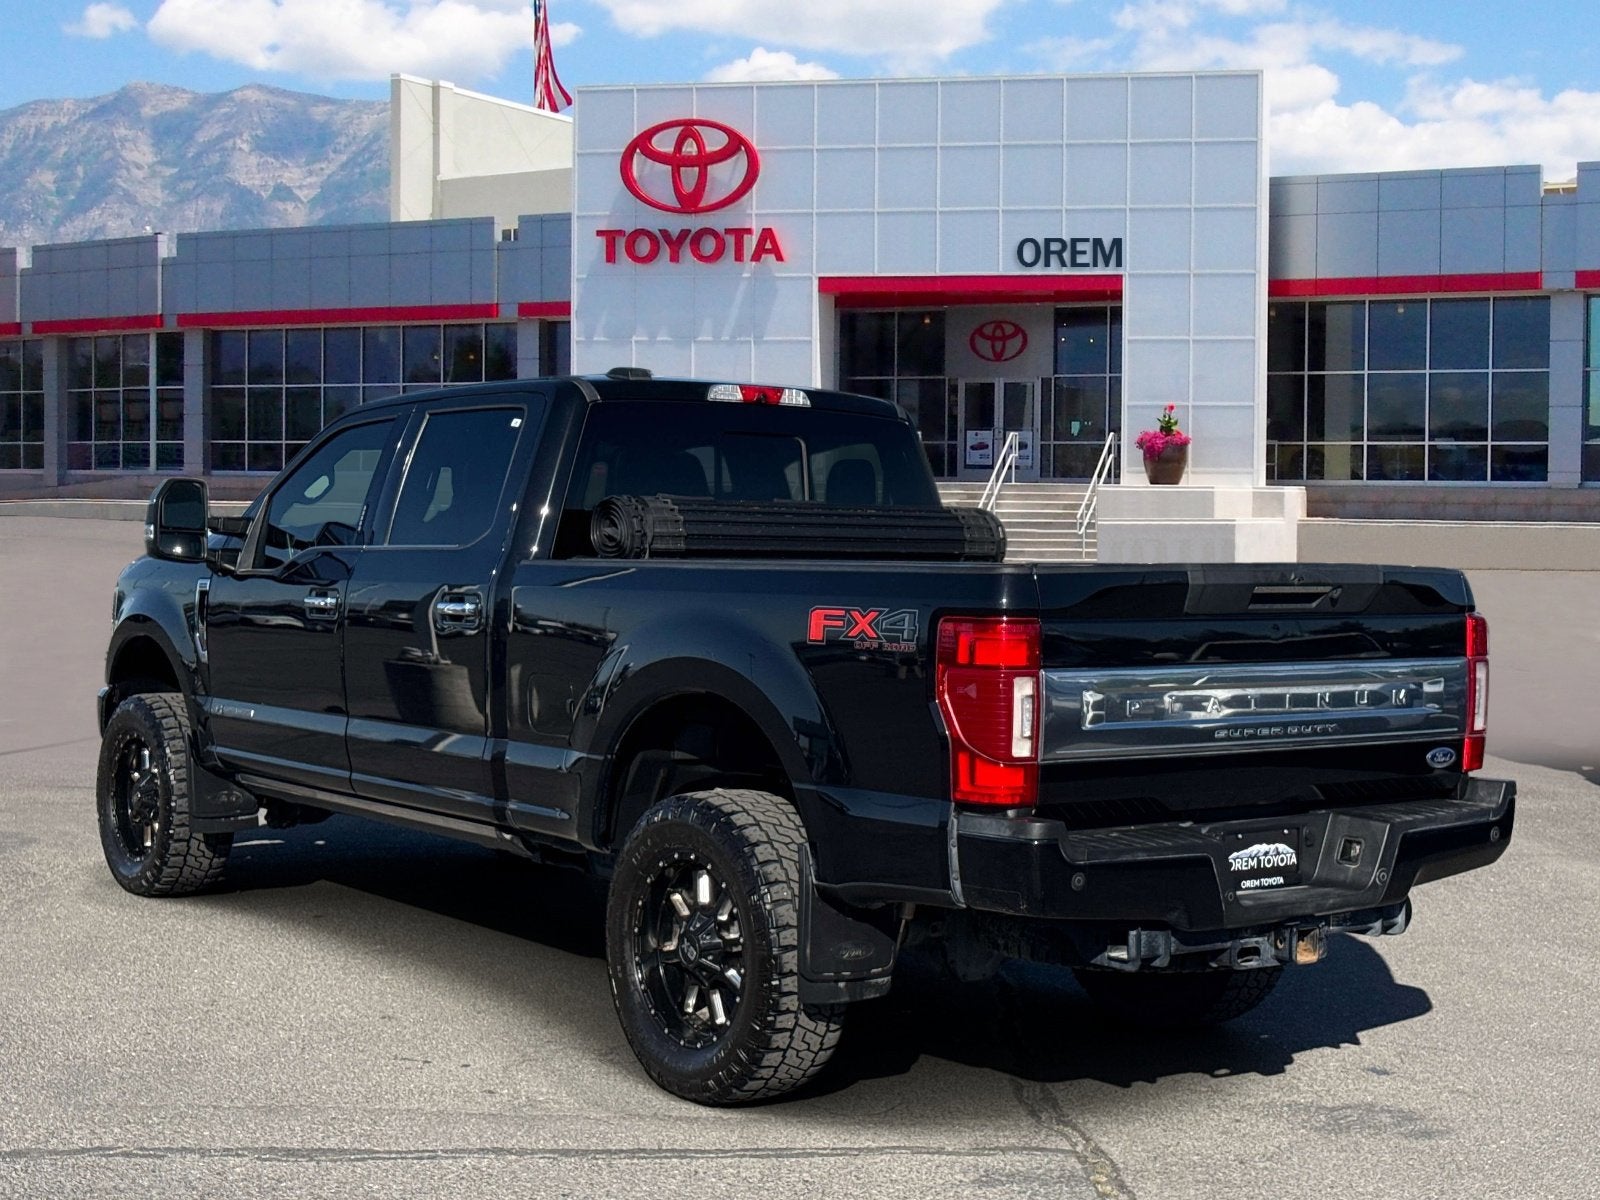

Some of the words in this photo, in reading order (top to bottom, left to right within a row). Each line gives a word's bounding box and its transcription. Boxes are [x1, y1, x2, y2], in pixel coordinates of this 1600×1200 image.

[596, 227, 785, 264] TOYOTA
[1016, 237, 1123, 268] OREM
[807, 605, 919, 645] FX4
[854, 641, 879, 650] OFF
[1214, 727, 1284, 739] SUPER
[1287, 723, 1338, 735] DUTY
[1260, 853, 1297, 868] TOYOTA
[1241, 879, 1260, 889] OREM
[1261, 876, 1284, 886] TOYOTA
